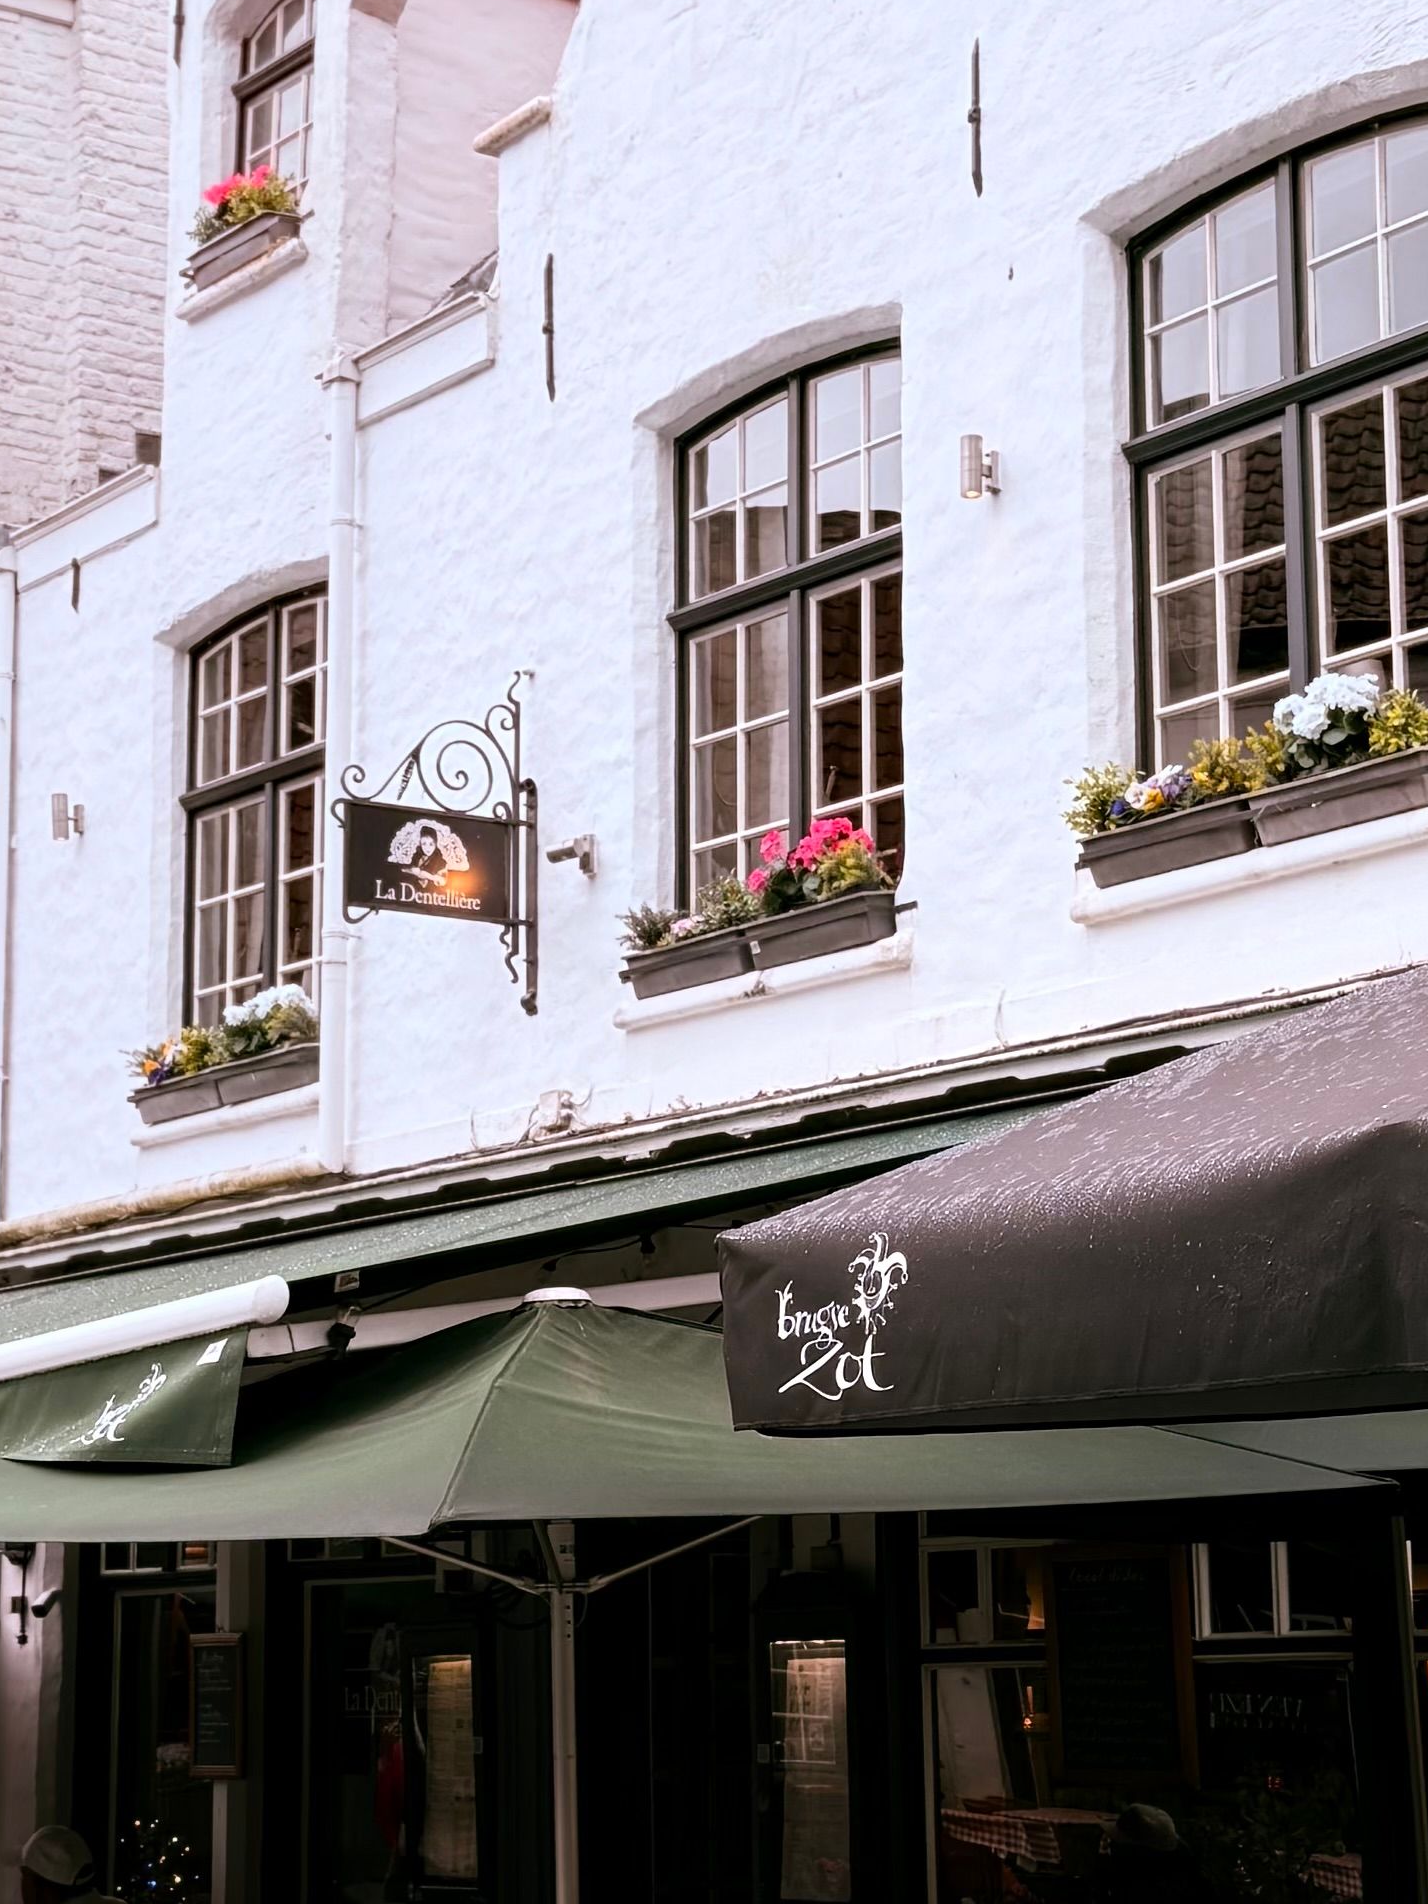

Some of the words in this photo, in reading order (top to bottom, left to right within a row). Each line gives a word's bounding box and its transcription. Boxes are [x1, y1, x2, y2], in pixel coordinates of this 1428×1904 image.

[375, 879, 396, 900] La
[400, 882, 481, 910] Dentellière
[775, 1281, 850, 1349] brugse
[778, 1334, 894, 1401] Zot
